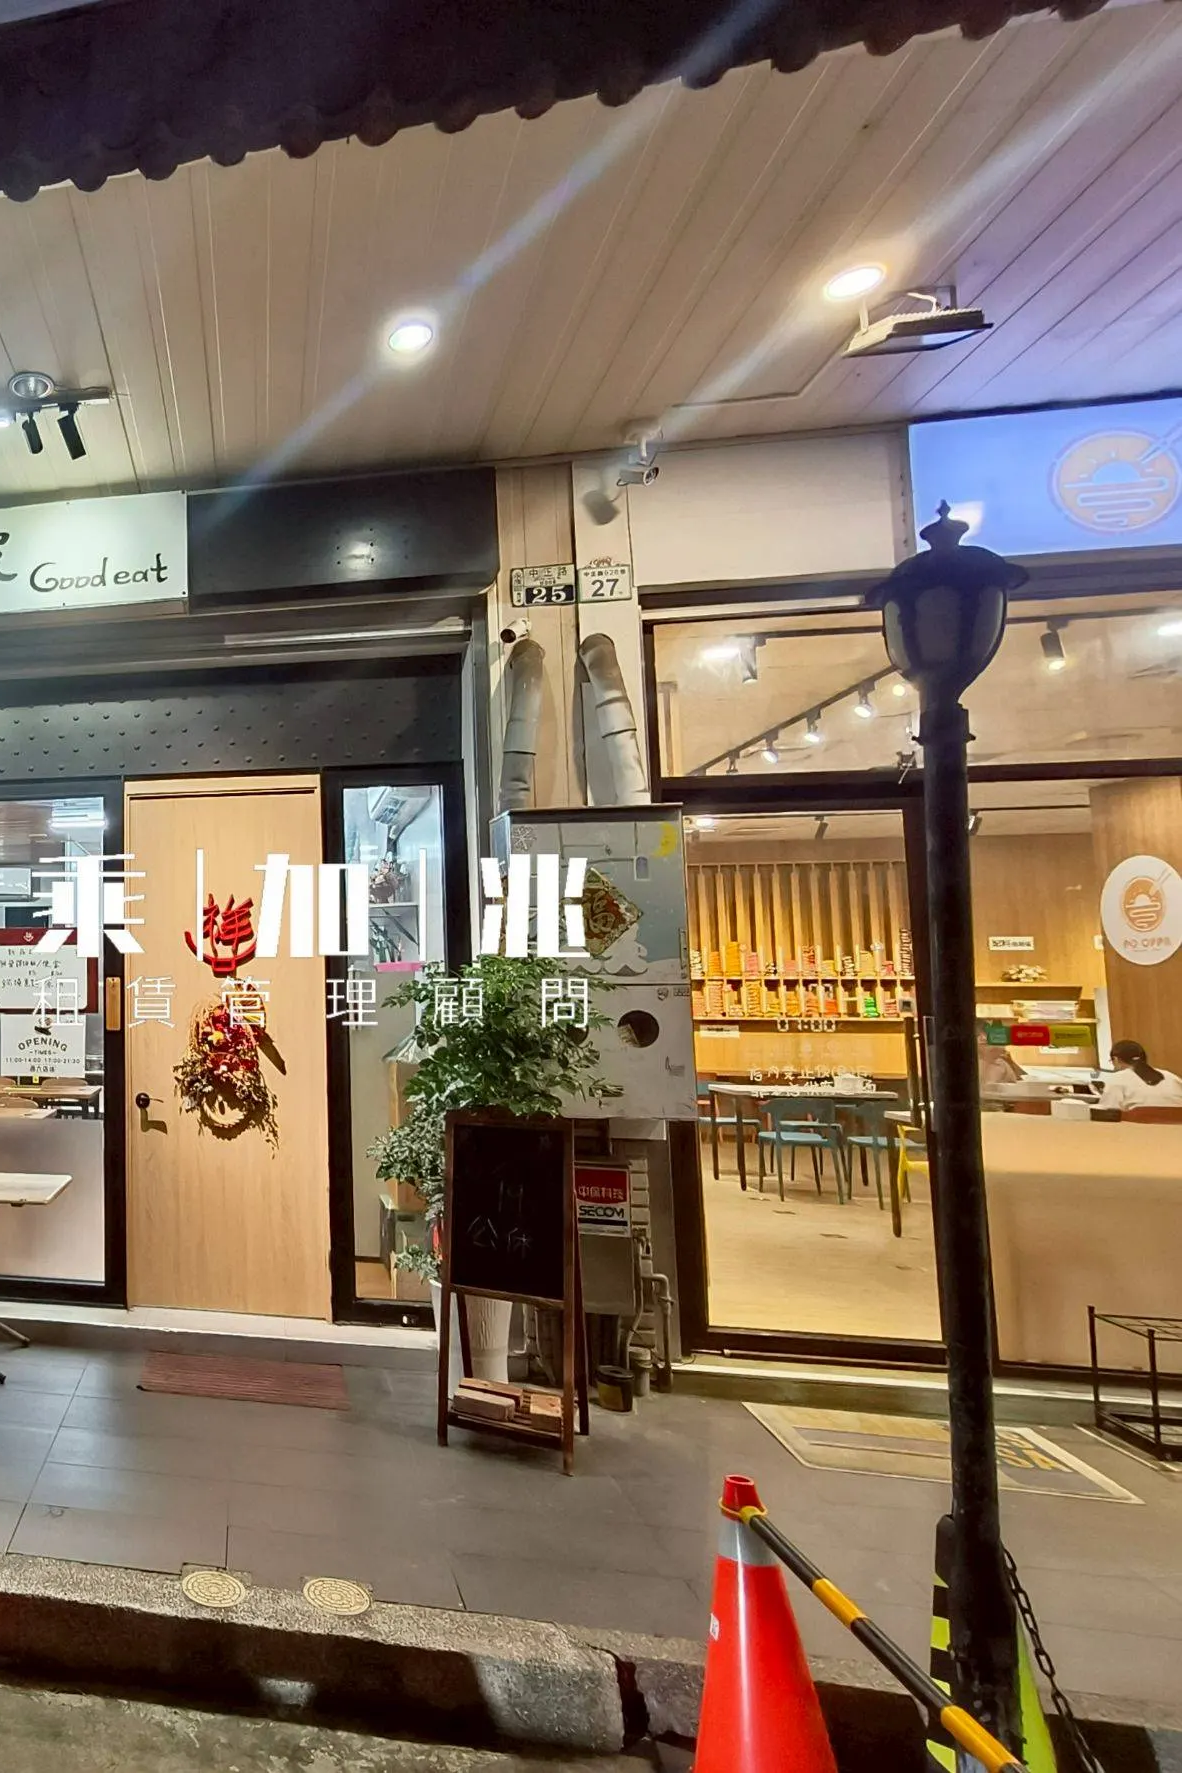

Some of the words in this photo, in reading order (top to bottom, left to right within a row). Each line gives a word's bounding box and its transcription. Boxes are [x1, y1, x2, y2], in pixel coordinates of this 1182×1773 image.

[30, 557, 108, 593] Good
[113, 553, 169, 585] eat
[532, 586, 567, 603] 25
[591, 578, 619, 597] 27
[18, 1037, 68, 1052] OPENING
[578, 1205, 625, 1218] SECOM
